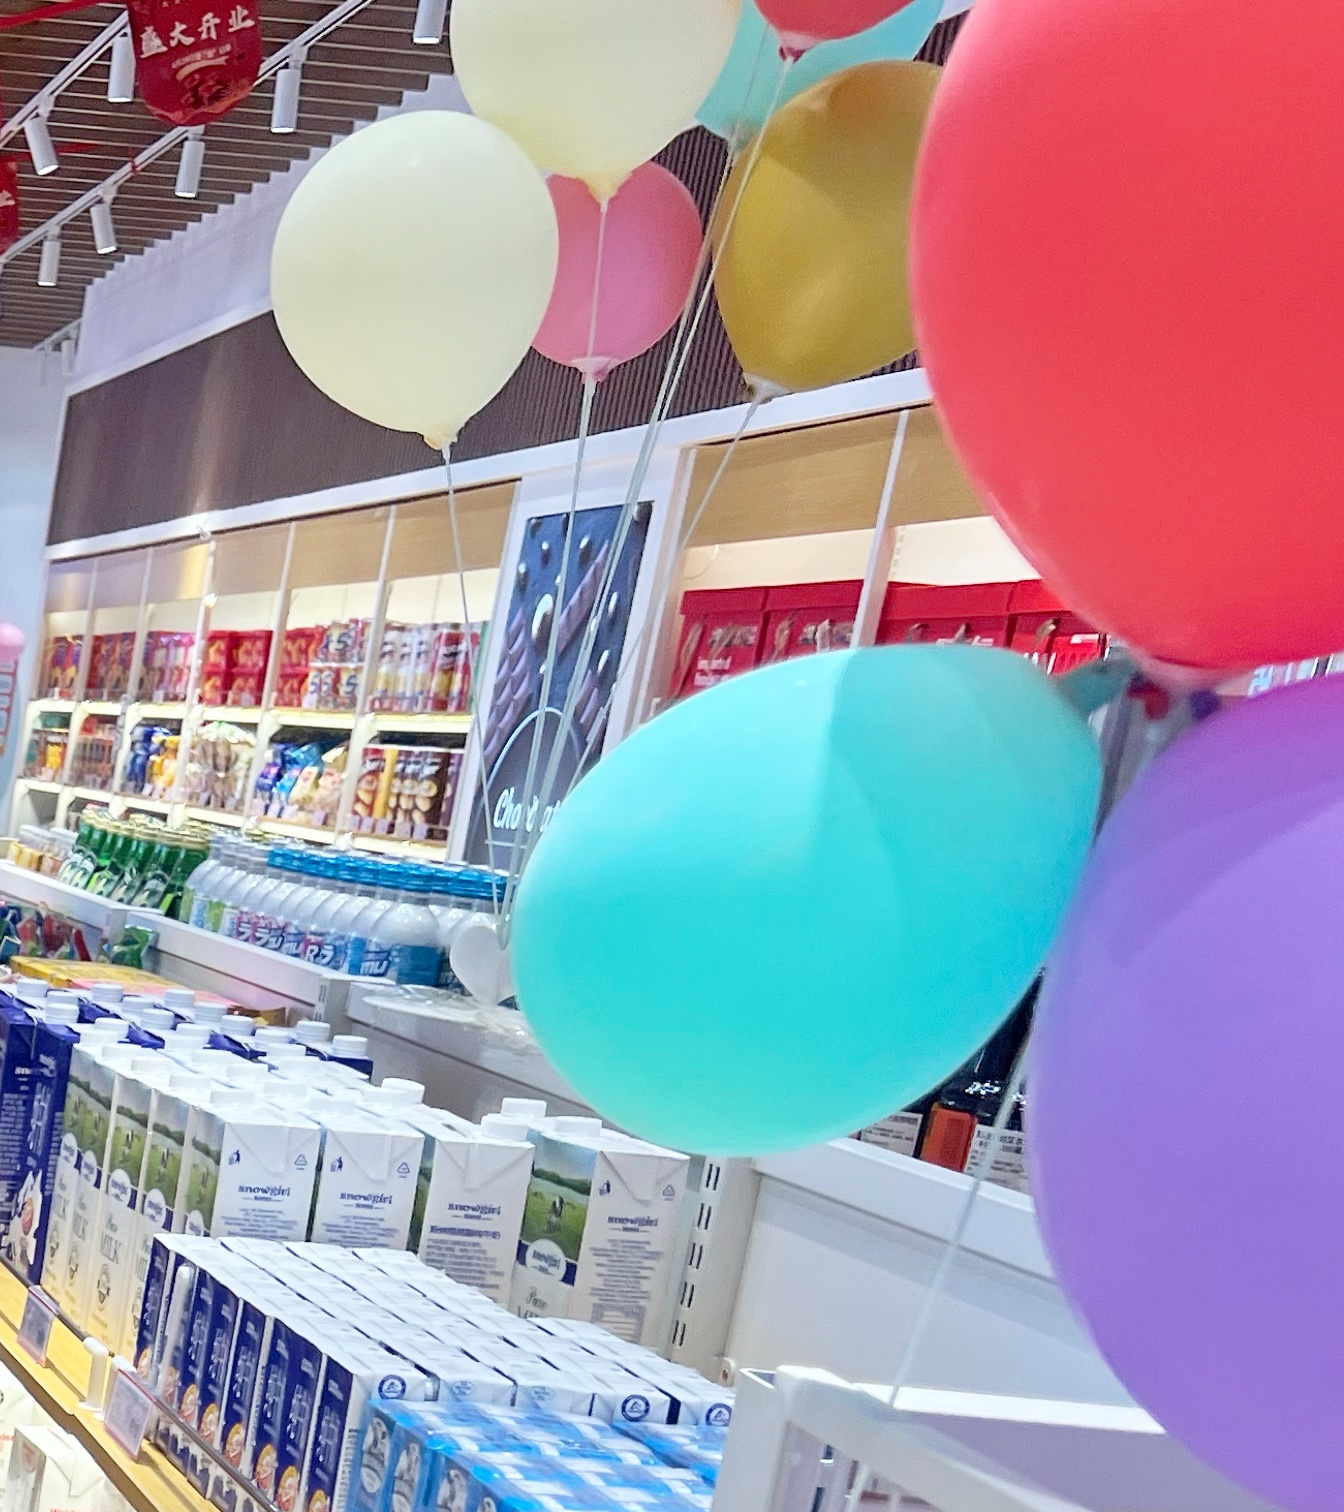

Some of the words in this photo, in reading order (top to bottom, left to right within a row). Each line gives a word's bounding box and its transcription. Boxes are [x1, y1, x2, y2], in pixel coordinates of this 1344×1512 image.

[140, 4, 256, 58] 盛大开业
[238, 1184, 291, 1198] snowgirl
[340, 1191, 393, 1206] snowgirl
[448, 1203, 501, 1216] snowgirl
[607, 1215, 659, 1228] snowgirl
